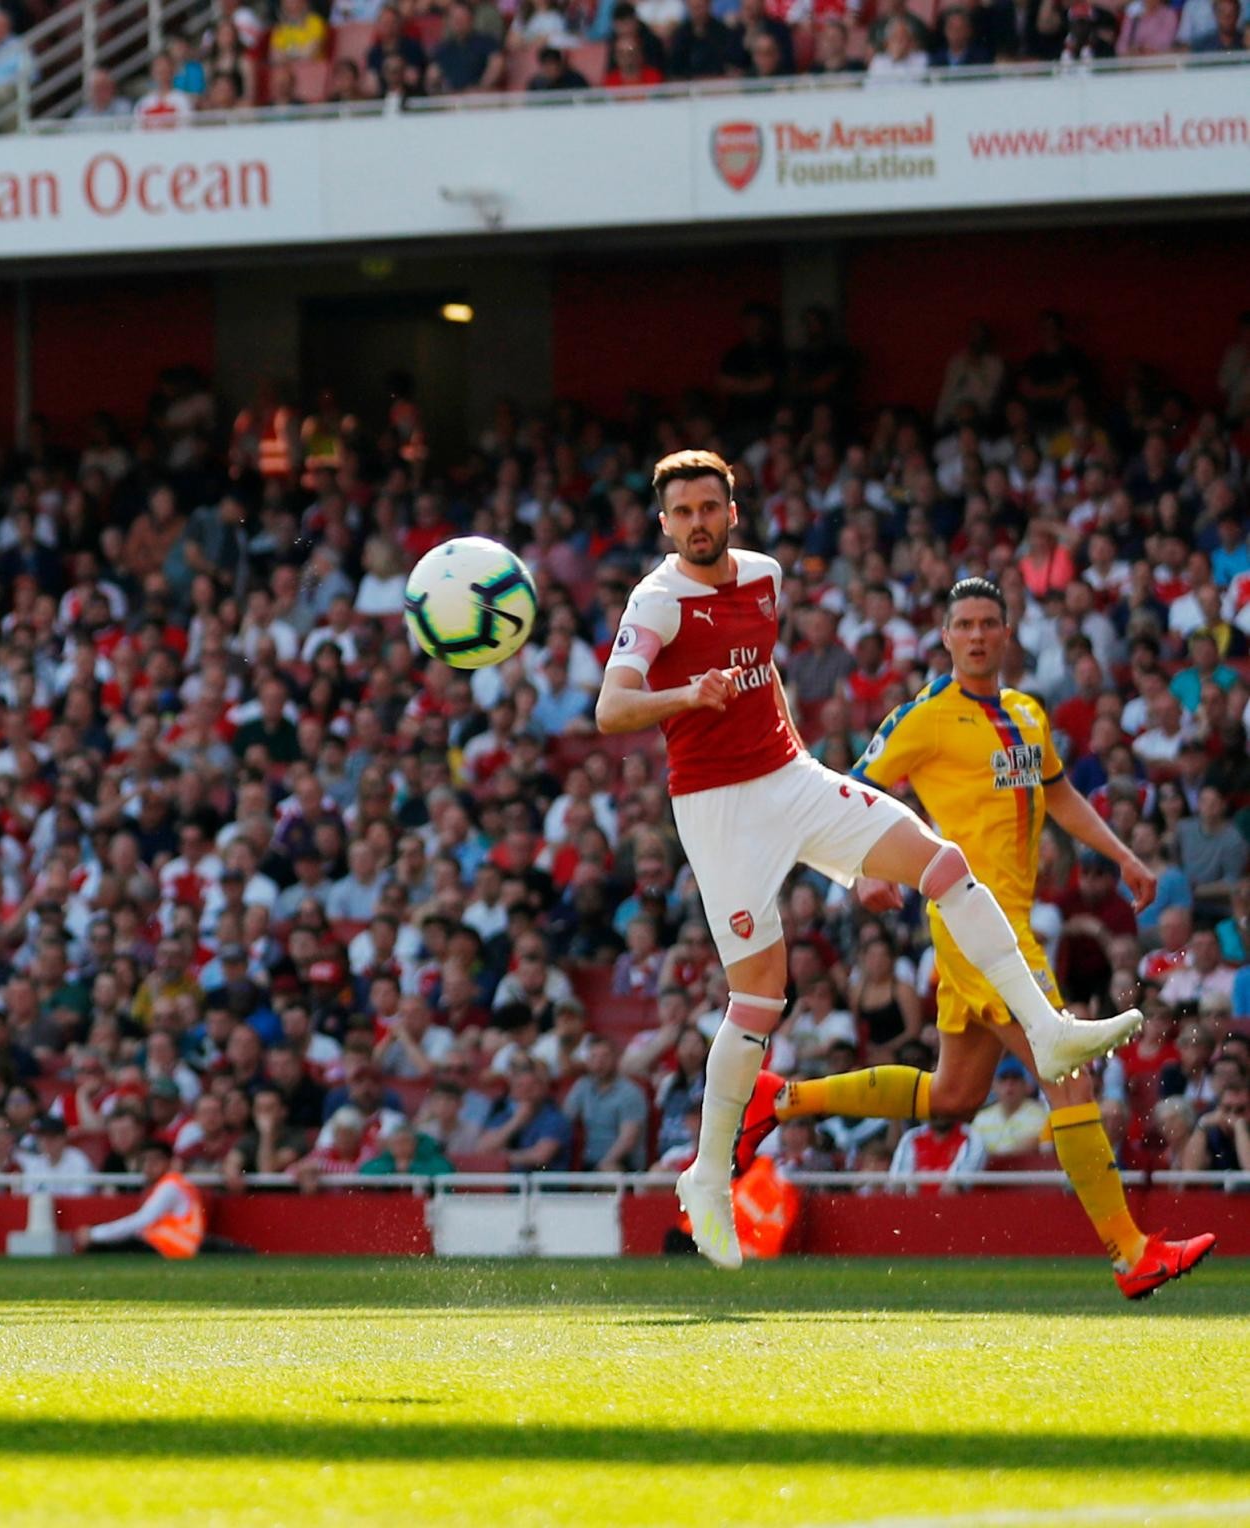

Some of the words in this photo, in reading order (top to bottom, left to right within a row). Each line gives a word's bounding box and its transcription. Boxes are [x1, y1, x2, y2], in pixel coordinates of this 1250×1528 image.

[772, 122, 821, 151] The
[828, 113, 934, 149] Arsenal
[83, 152, 271, 217] Ocean
[777, 154, 935, 185] Foundation
[730, 646, 758, 668] Fly
